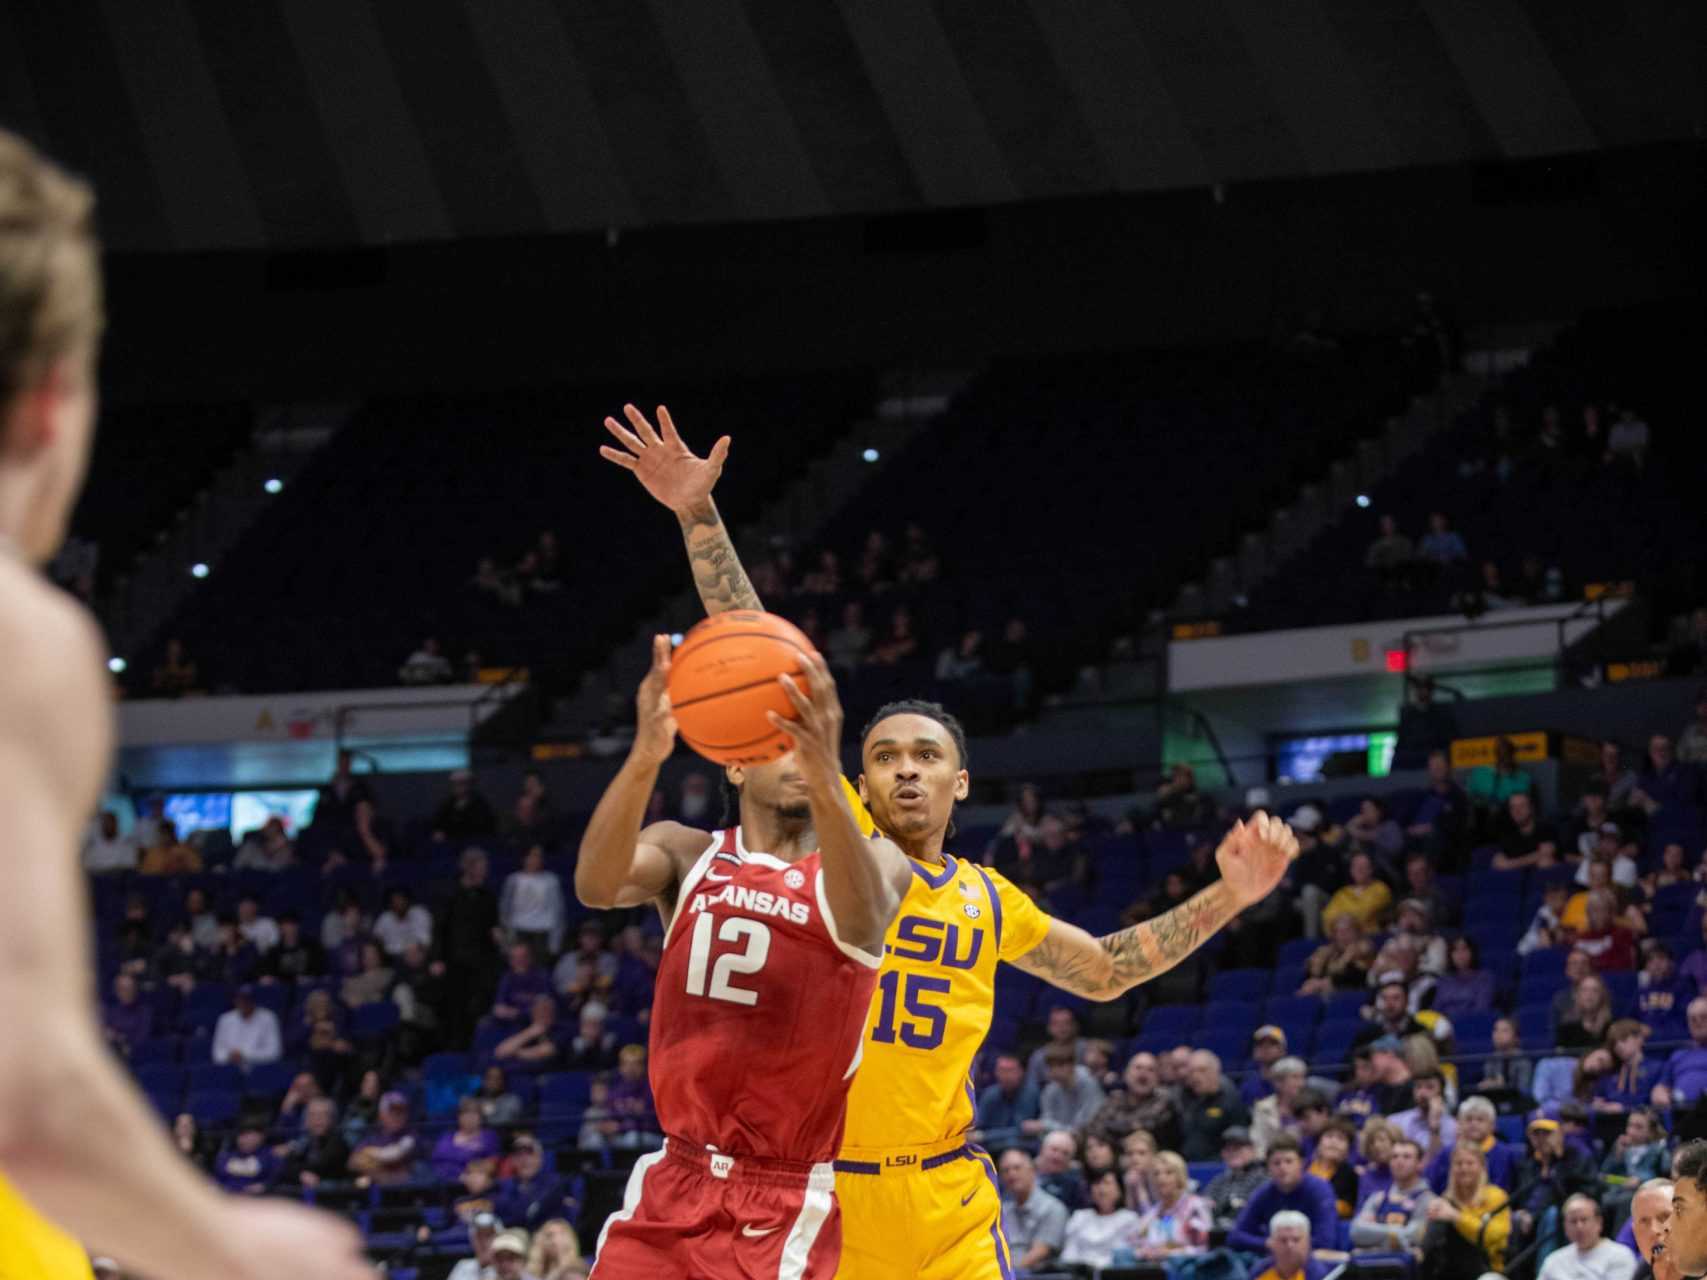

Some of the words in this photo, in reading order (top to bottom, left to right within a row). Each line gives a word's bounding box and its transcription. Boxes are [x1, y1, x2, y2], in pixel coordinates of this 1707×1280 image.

[686, 911, 771, 1006] 12
[885, 915, 984, 970] SU
[871, 970, 951, 1050] 15
[885, 1154, 917, 1167] LSU
